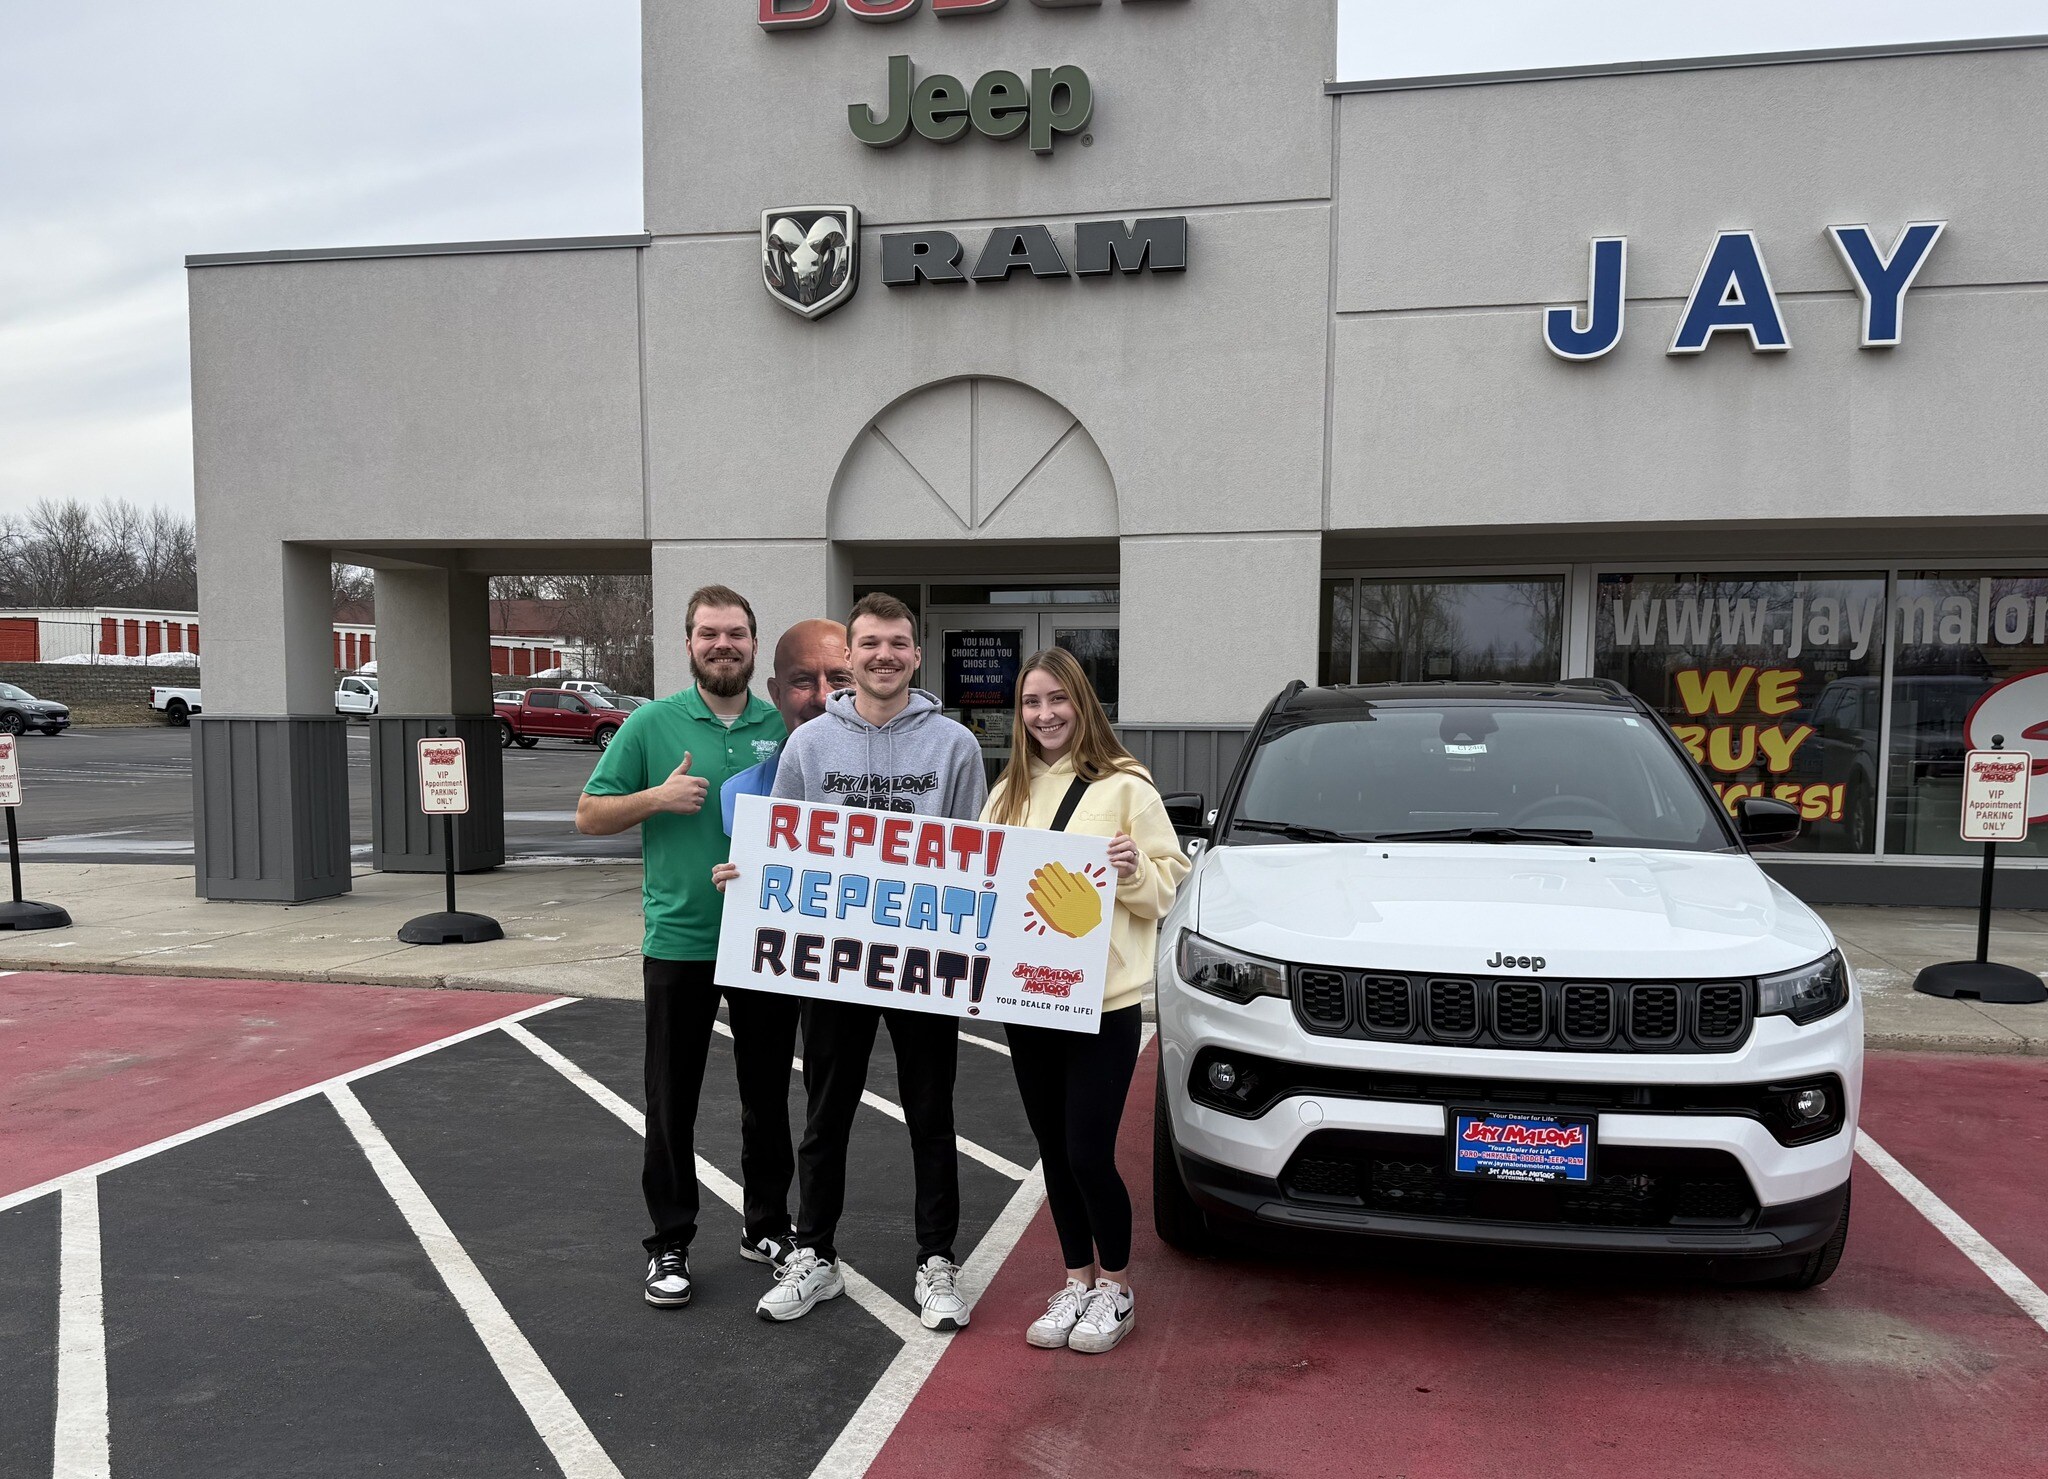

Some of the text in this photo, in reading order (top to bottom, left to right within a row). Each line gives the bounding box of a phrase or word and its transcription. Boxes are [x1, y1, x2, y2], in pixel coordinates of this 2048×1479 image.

[848, 55, 1092, 154] Jeep
[880, 216, 1187, 288] RAM
[1542, 220, 1947, 362] JAY
[962, 637, 1002, 646] YOU HAD A
[951, 648, 1012, 658] CHOICE AND YOU
[963, 659, 1001, 668] CHOSE US.
[1813, 661, 1848, 671] WIFE!
[960, 674, 1003, 683] THANK YOU!
[1676, 665, 1802, 717] WE
[437, 771, 449, 779] VIP
[425, 780, 463, 788] Appointment
[822, 771, 938, 795] JAY MALONE
[431, 788, 458, 796] PARKING
[1988, 789, 2004, 799] VIP
[436, 797, 453, 805] ONLY
[1969, 800, 2022, 809] Appointment
[1976, 811, 2013, 820] PARKING
[1983, 822, 2005, 830] ONLY
[767, 803, 1005, 889] REPEAT!
[759, 864, 997, 951] REPEAT!
[1486, 951, 1546, 972] Jeep
[752, 927, 991, 1015] REPEAT!
[1012, 963, 1084, 984] JAY MALONE
[1022, 979, 1071, 998] MOTORS
[996, 996, 1093, 1015] YOUR DEALER FOR LIFE!
[1462, 1121, 1583, 1148] JAY MALONE
[1477, 1160, 1566, 1171] www.jaymalonemotors.com
[1528, 1171, 1555, 1179] MOTORS
